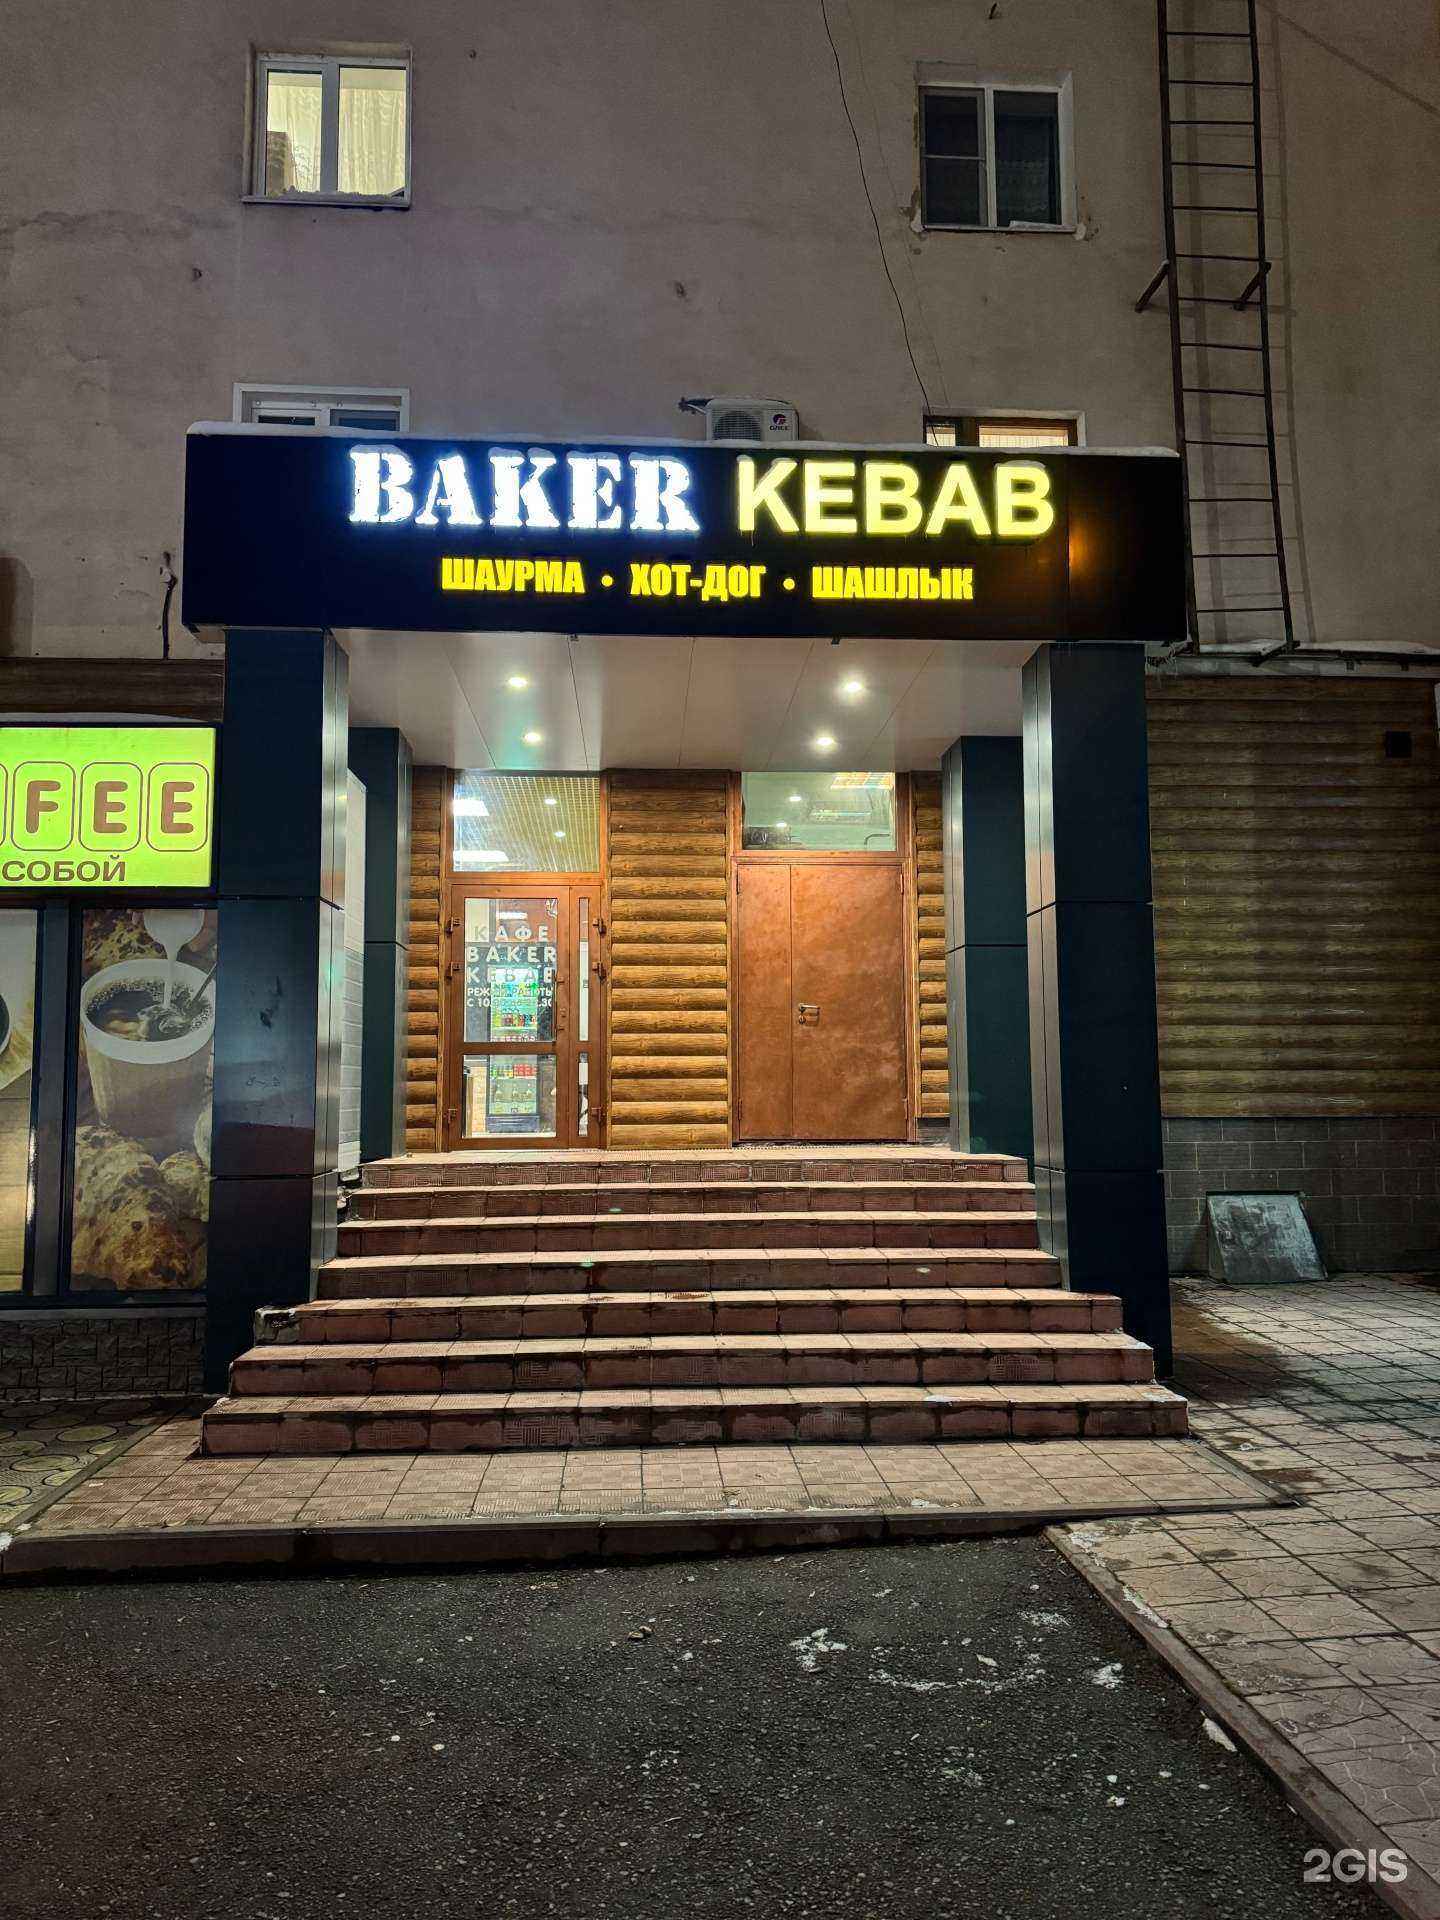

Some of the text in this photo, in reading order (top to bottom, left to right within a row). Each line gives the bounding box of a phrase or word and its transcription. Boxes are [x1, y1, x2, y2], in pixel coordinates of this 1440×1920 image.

[348, 446, 1055, 538] BAKER KEBAB
[441, 558, 975, 603] ШАУРМА ХОТ-ДОГ ШАШЛЫК
[2, 854, 126, 882] СОБОЙ
[474, 925, 549, 942] КАФЕ
[466, 946, 557, 963] BAKER
[466, 966, 553, 984] KEBAB
